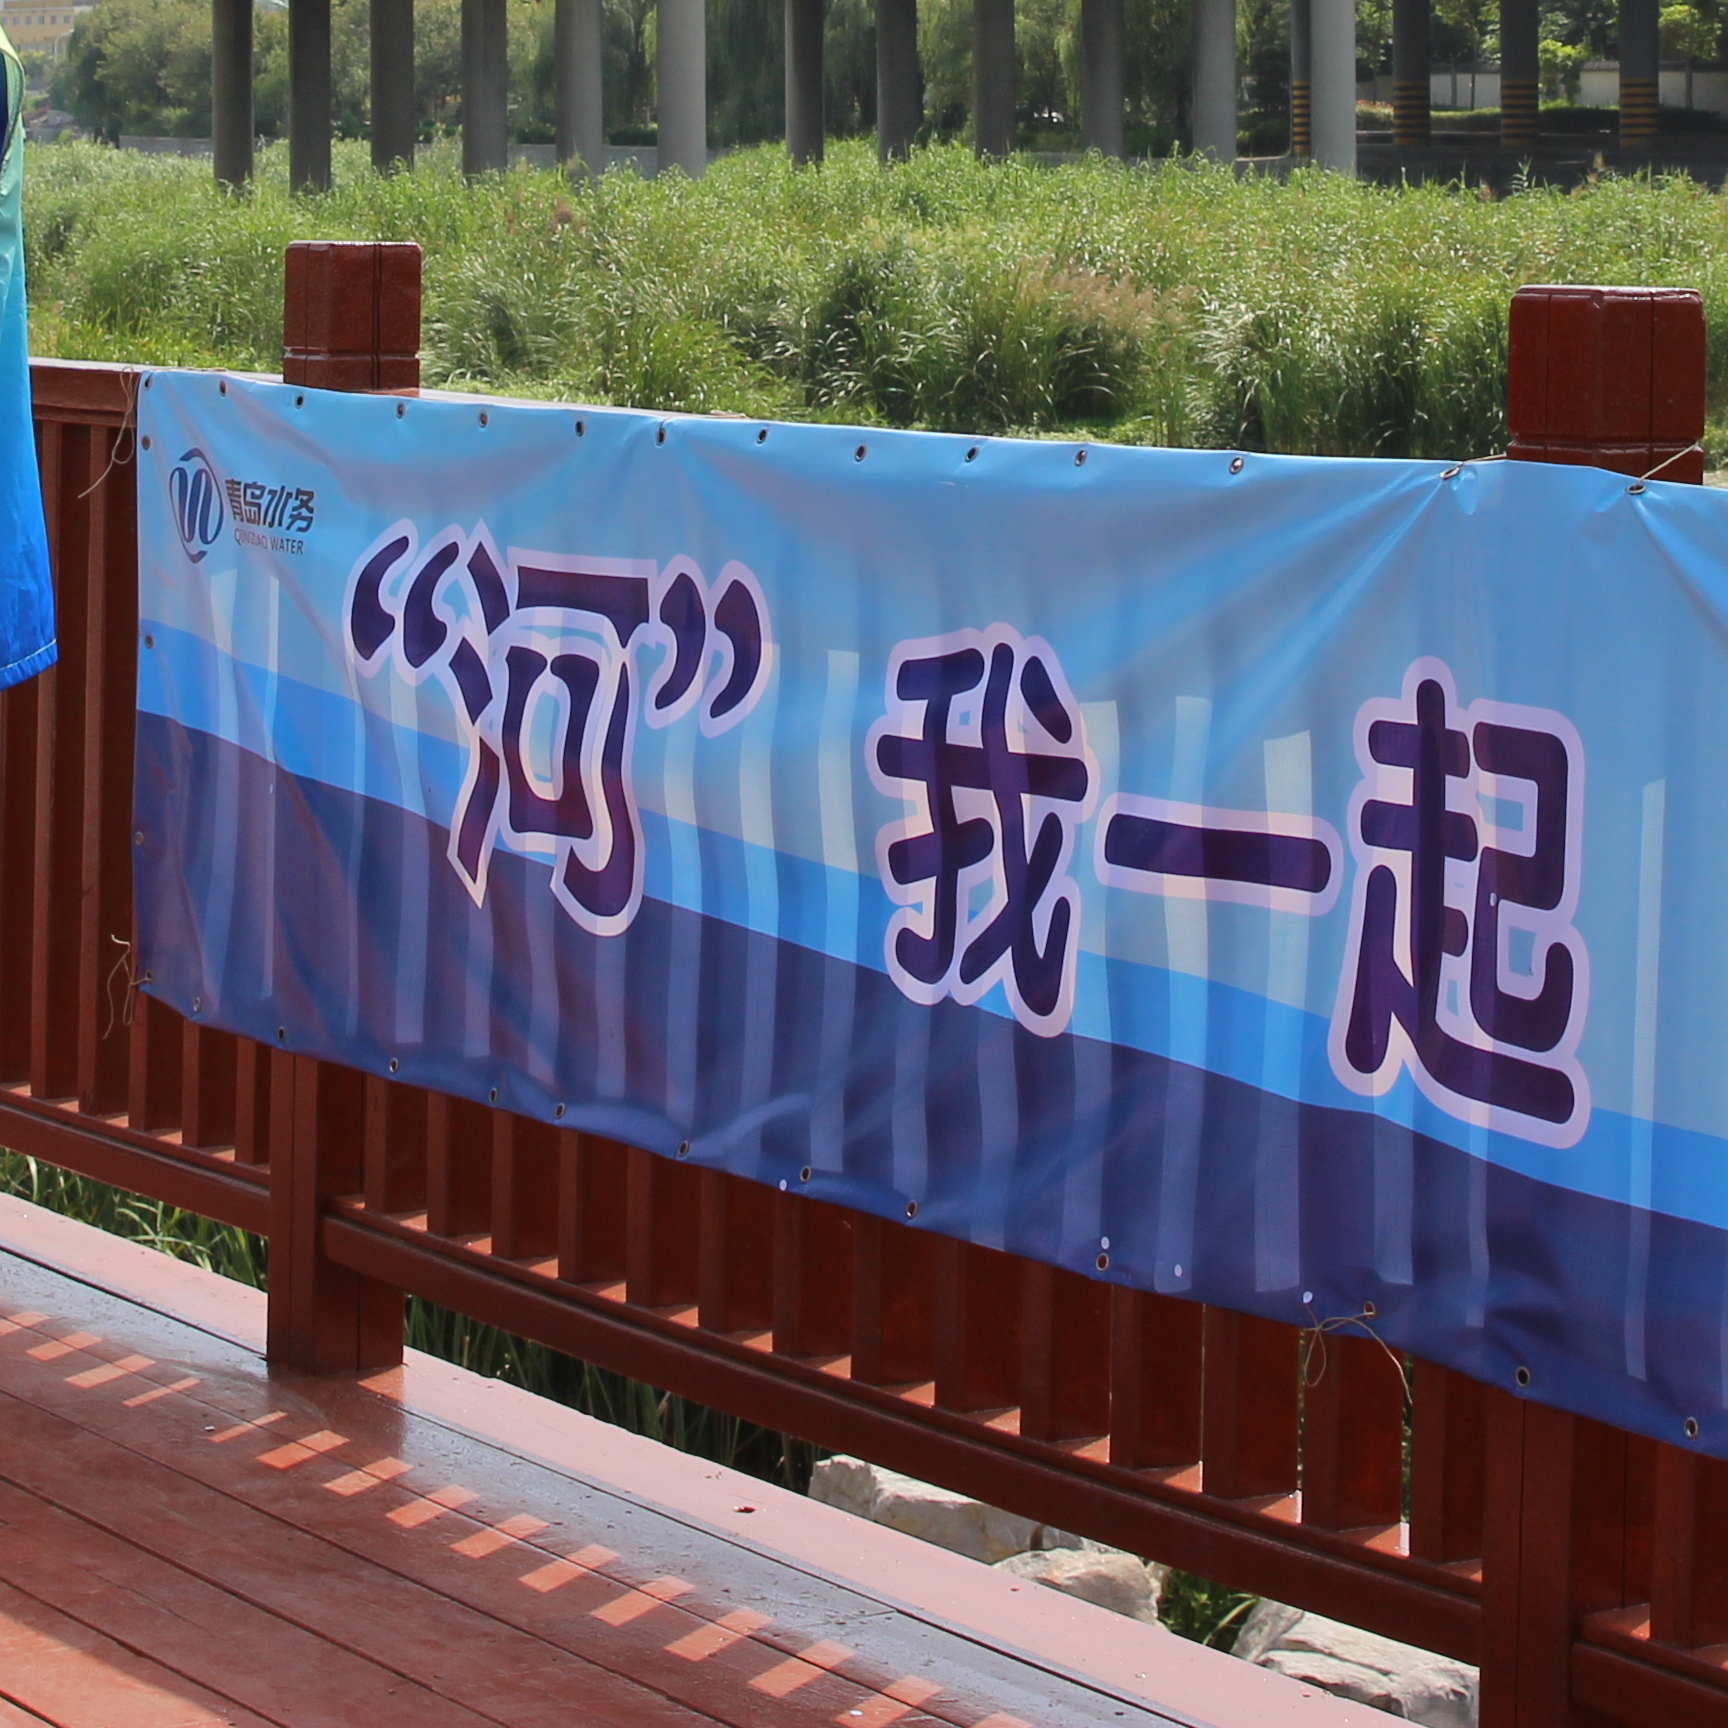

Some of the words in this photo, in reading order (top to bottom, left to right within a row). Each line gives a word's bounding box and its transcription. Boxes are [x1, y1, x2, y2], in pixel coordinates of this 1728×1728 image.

[225, 479, 315, 533] 青岛水务
[234, 528, 268, 549] QINGDAO
[270, 536, 304, 555] WATER
